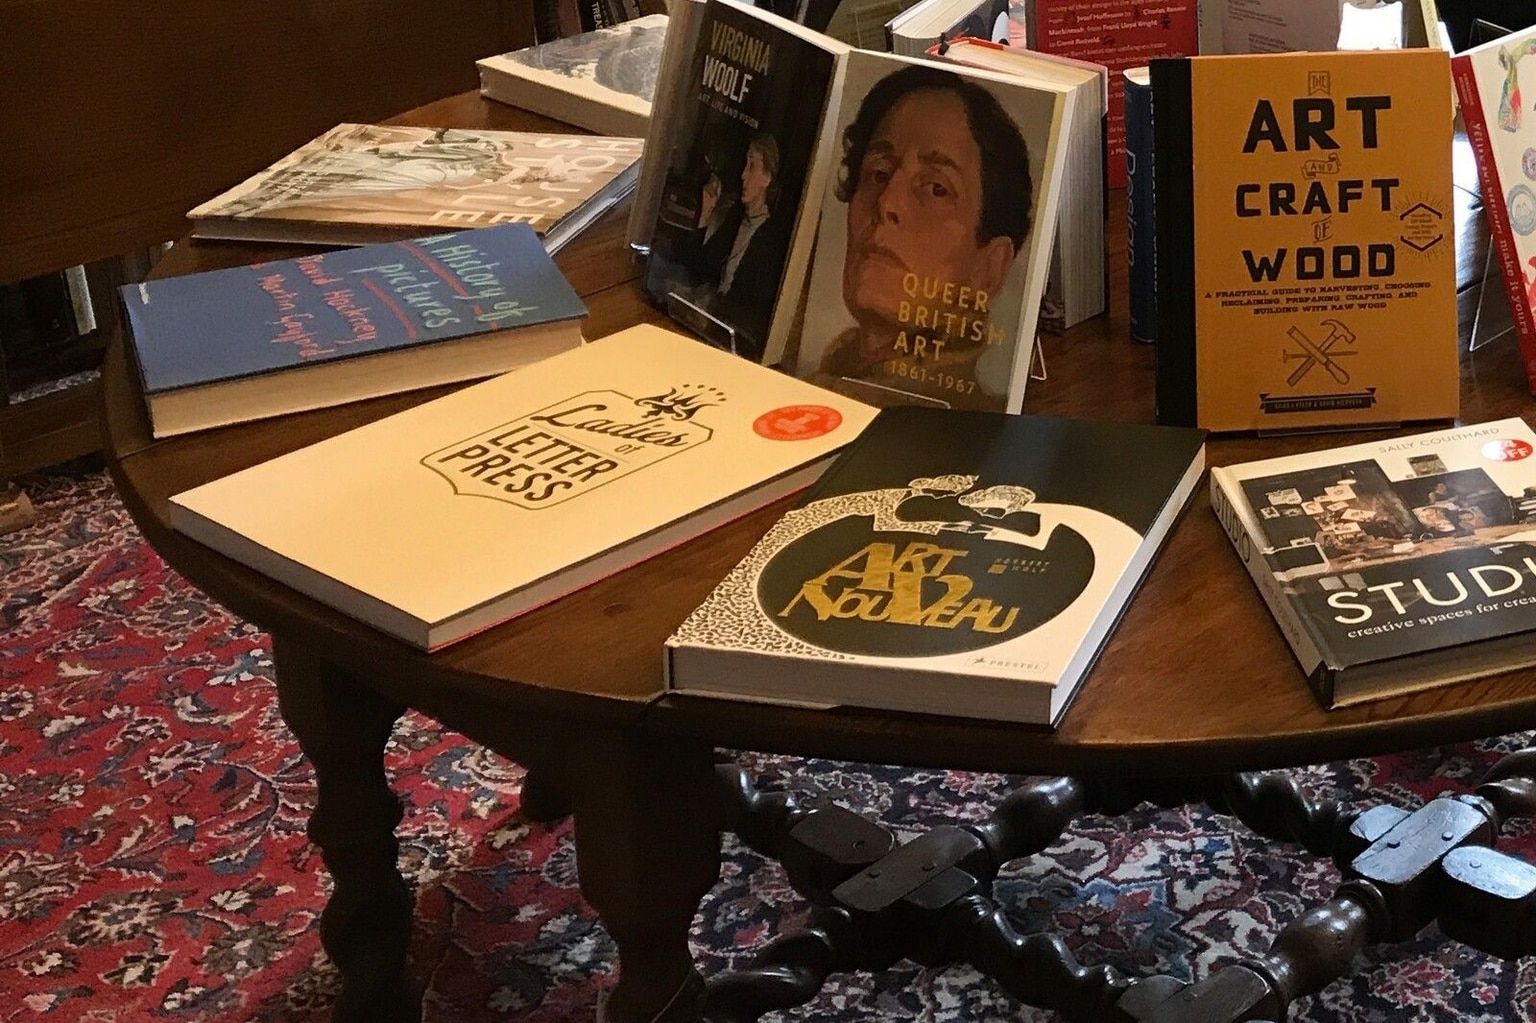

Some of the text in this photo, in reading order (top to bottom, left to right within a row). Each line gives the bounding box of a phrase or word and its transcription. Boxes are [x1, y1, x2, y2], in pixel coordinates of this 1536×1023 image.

[711, 20, 771, 76] VIRGINIA
[702, 54, 753, 104] WOOLF
[1311, 75, 1327, 87] THE
[1242, 96, 1391, 153] ART
[1310, 162, 1333, 172] AND
[1235, 179, 1399, 217] CRAFT
[1242, 243, 1395, 282] WOOD
[254, 273, 299, 311] Martin
[299, 254, 378, 345] David Hockney
[348, 262, 461, 330] pictures
[430, 244, 505, 301] History
[478, 300, 540, 323] of
[903, 273, 988, 313] QUEER
[1215, 288, 1269, 298] PRACTICAL
[1272, 287, 1301, 296] GUIDE
[1303, 286, 1316, 294] TO
[1319, 284, 1380, 293] HARVESTING
[1397, 290, 1418, 299] AND
[1500, 239, 1514, 277] make
[1511, 292, 1528, 335] yours
[898, 301, 1005, 346] BRITISH
[1253, 302, 1387, 315] BUILDING WITH RAW WOOD
[893, 331, 945, 361] ART
[890, 360, 976, 395] 1861-1967
[530, 404, 689, 447] Ladies
[1378, 426, 1500, 455] SALLY COULTHARD
[487, 425, 618, 483] LETTER
[614, 443, 645, 455] of
[437, 444, 573, 501] PRESS
[1213, 483, 1251, 563] STUDIO
[803, 542, 969, 592] ART
[777, 574, 1020, 634] NOUVEAU
[1347, 618, 1415, 638] creative
[1418, 607, 1473, 628] spaces
[1477, 601, 1499, 615] for
